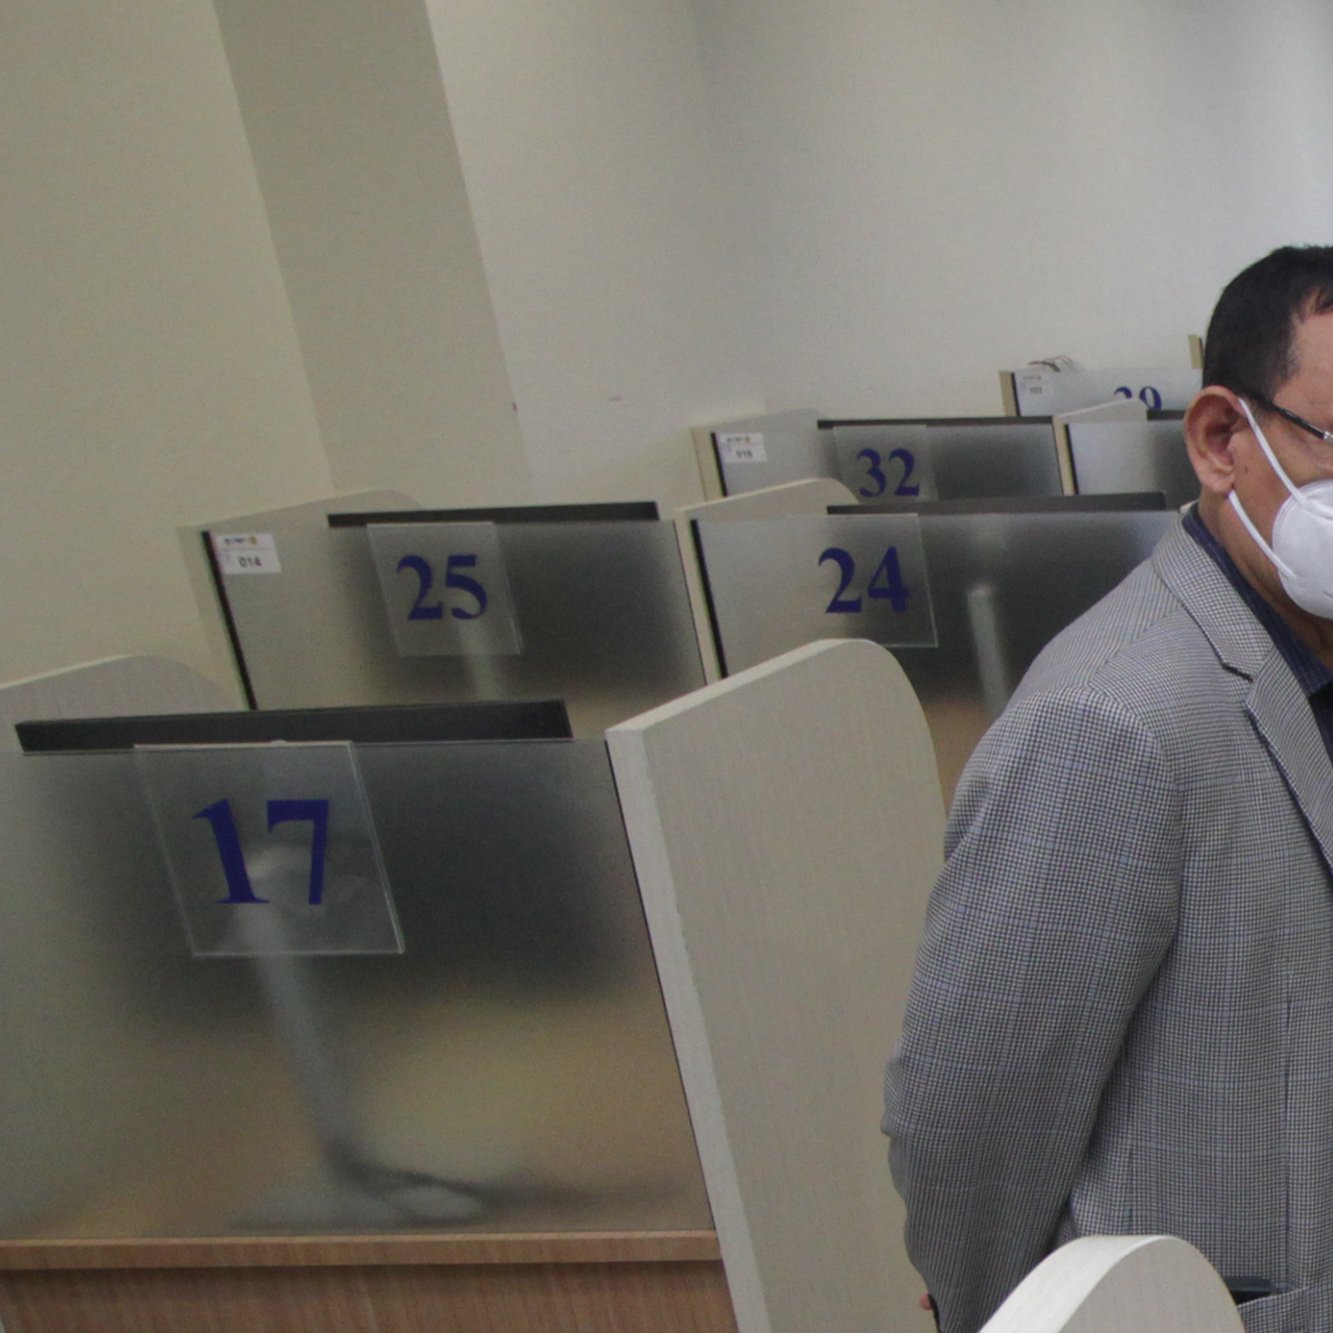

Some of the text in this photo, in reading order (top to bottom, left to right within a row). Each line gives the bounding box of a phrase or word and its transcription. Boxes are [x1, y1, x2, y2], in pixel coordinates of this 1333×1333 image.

[856, 448, 920, 497] 32
[396, 553, 488, 620] 25
[817, 546, 910, 613] 24
[193, 799, 330, 905] 17
